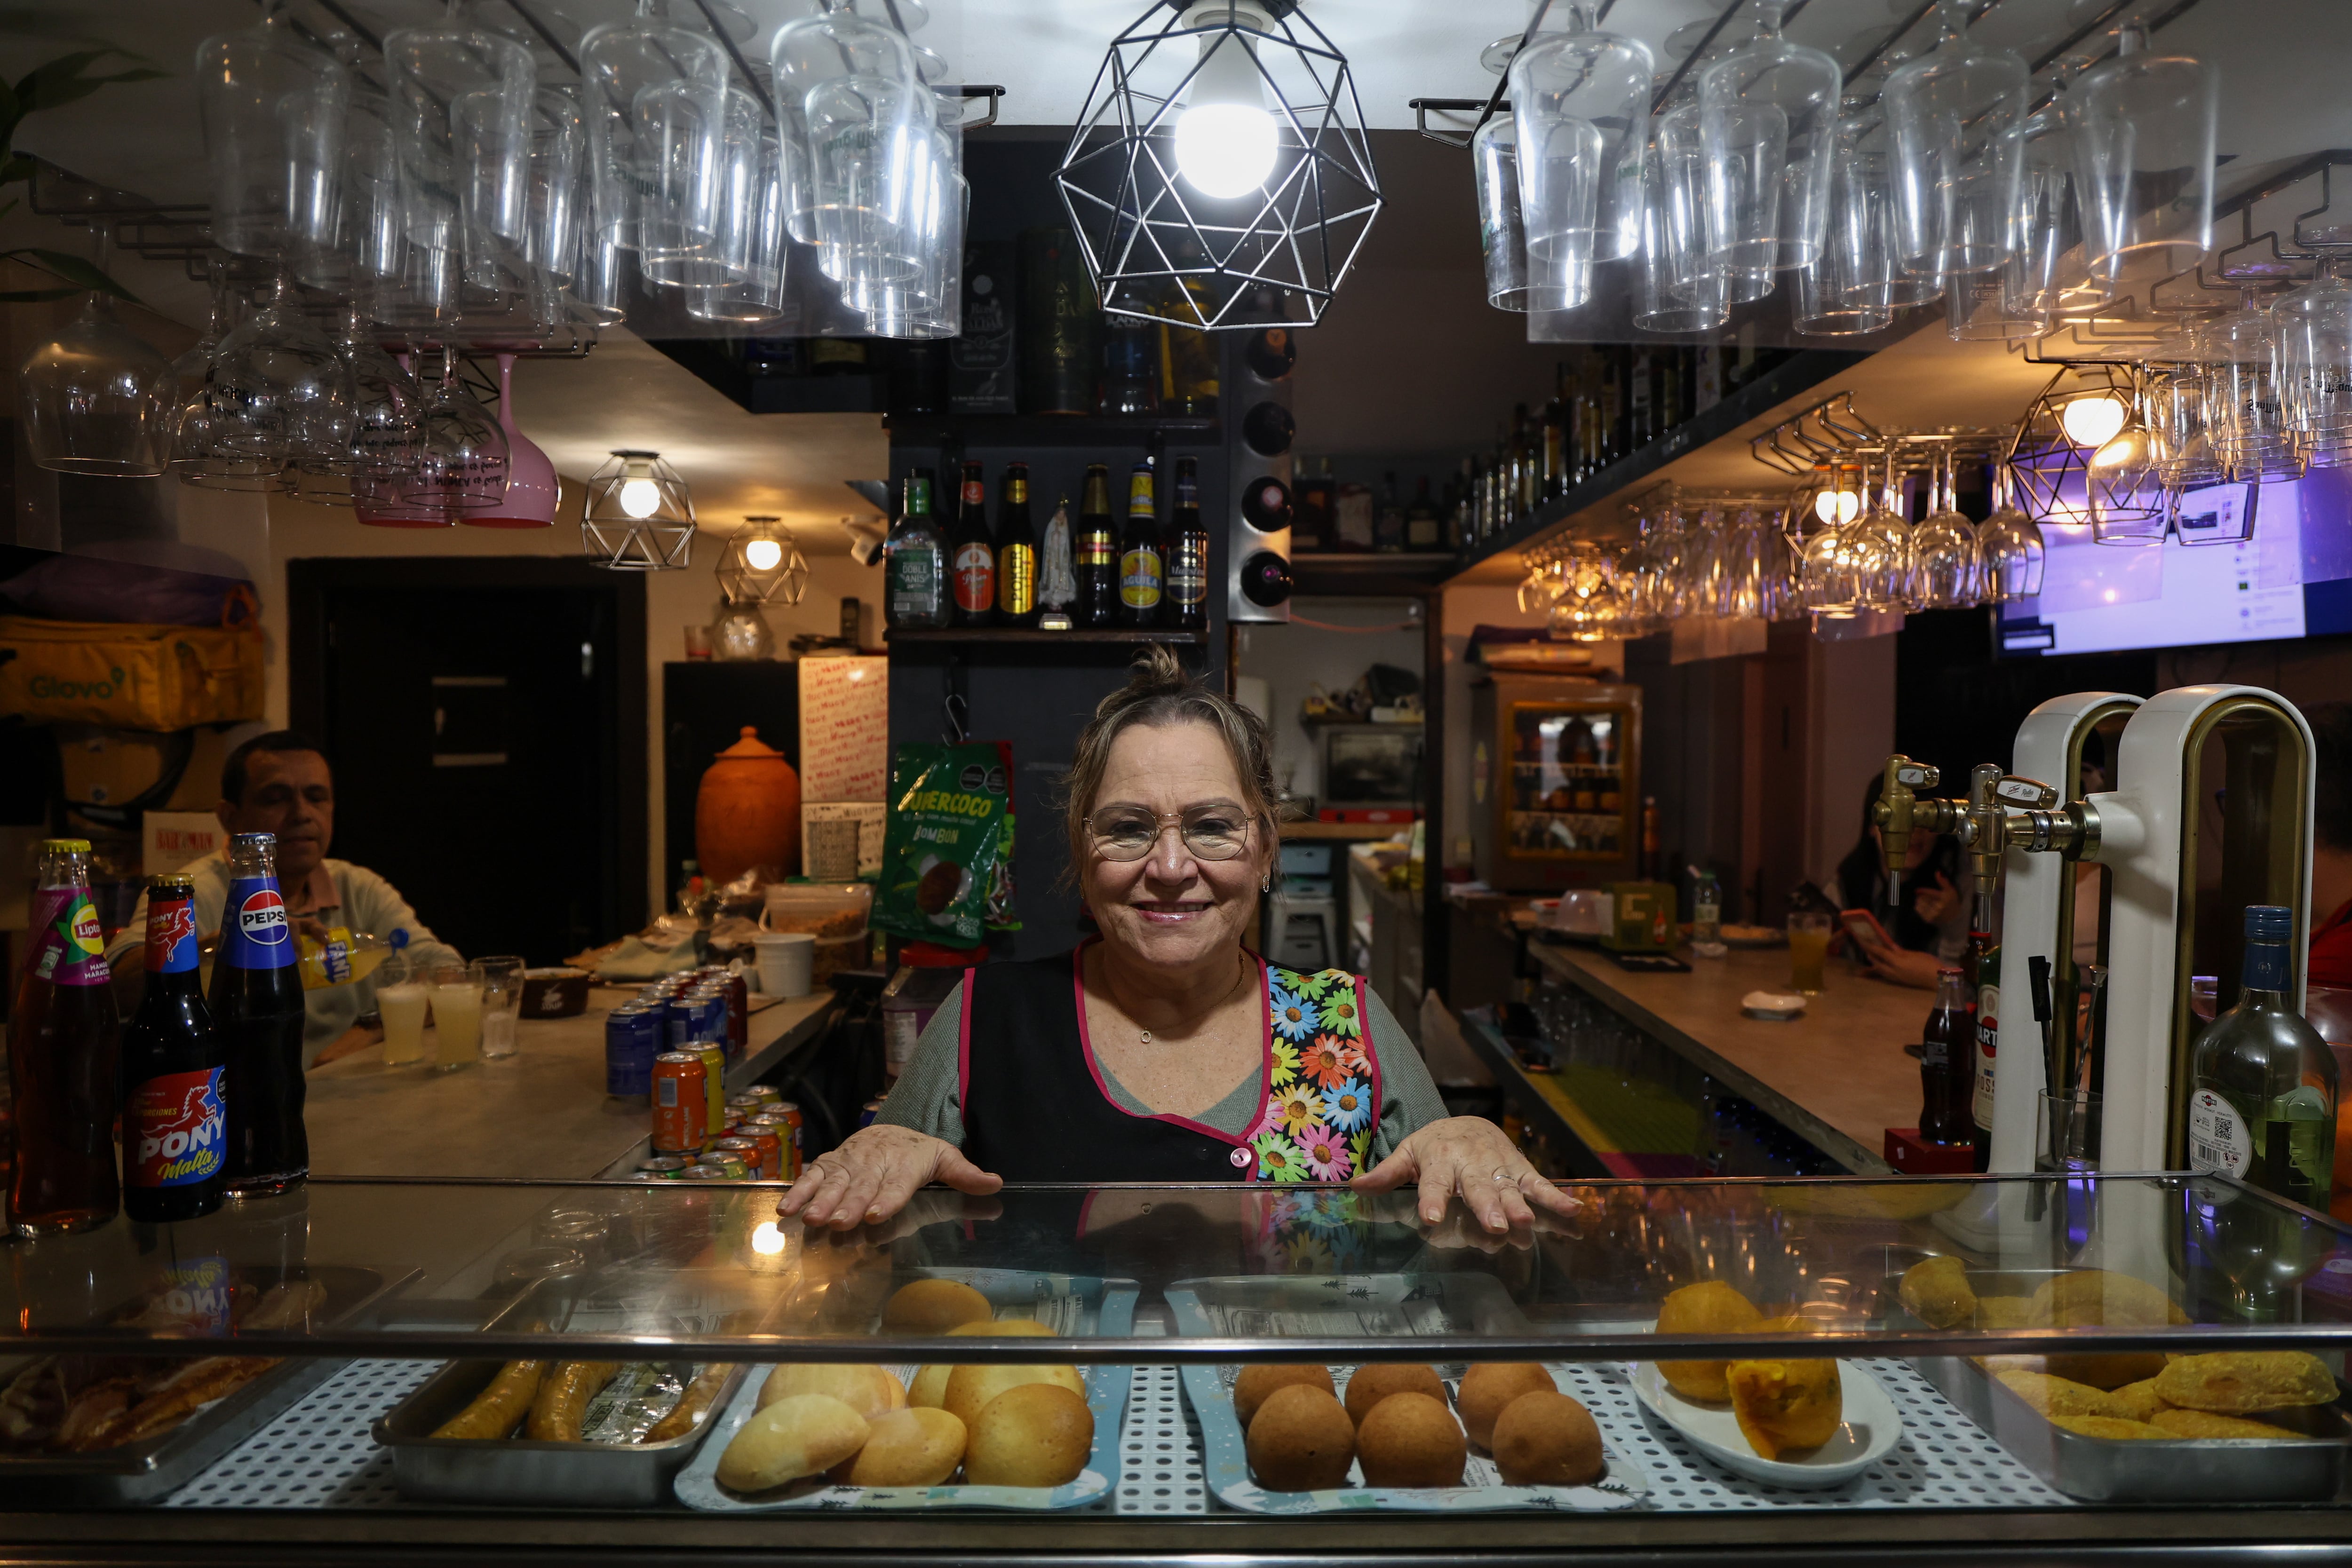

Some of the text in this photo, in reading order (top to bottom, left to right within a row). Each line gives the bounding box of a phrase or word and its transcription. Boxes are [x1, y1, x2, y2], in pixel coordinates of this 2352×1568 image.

[902, 564, 927, 574] DOBLE
[1011, 551, 1022, 601] POKER
[1123, 575, 1159, 588] AGUILA
[30, 674, 114, 700] Glovo
[901, 790, 993, 818] UPERCOCO
[149, 911, 174, 926] PONY
[242, 910, 286, 927] PEPSI
[78, 922, 101, 937] Lipto
[90, 961, 108, 971] MANGO
[84, 968, 111, 980] MARACU
[2201, 1096, 2217, 1106] MARTINI
[137, 1110, 225, 1165] PONY
[157, 1147, 214, 1180] Malta
